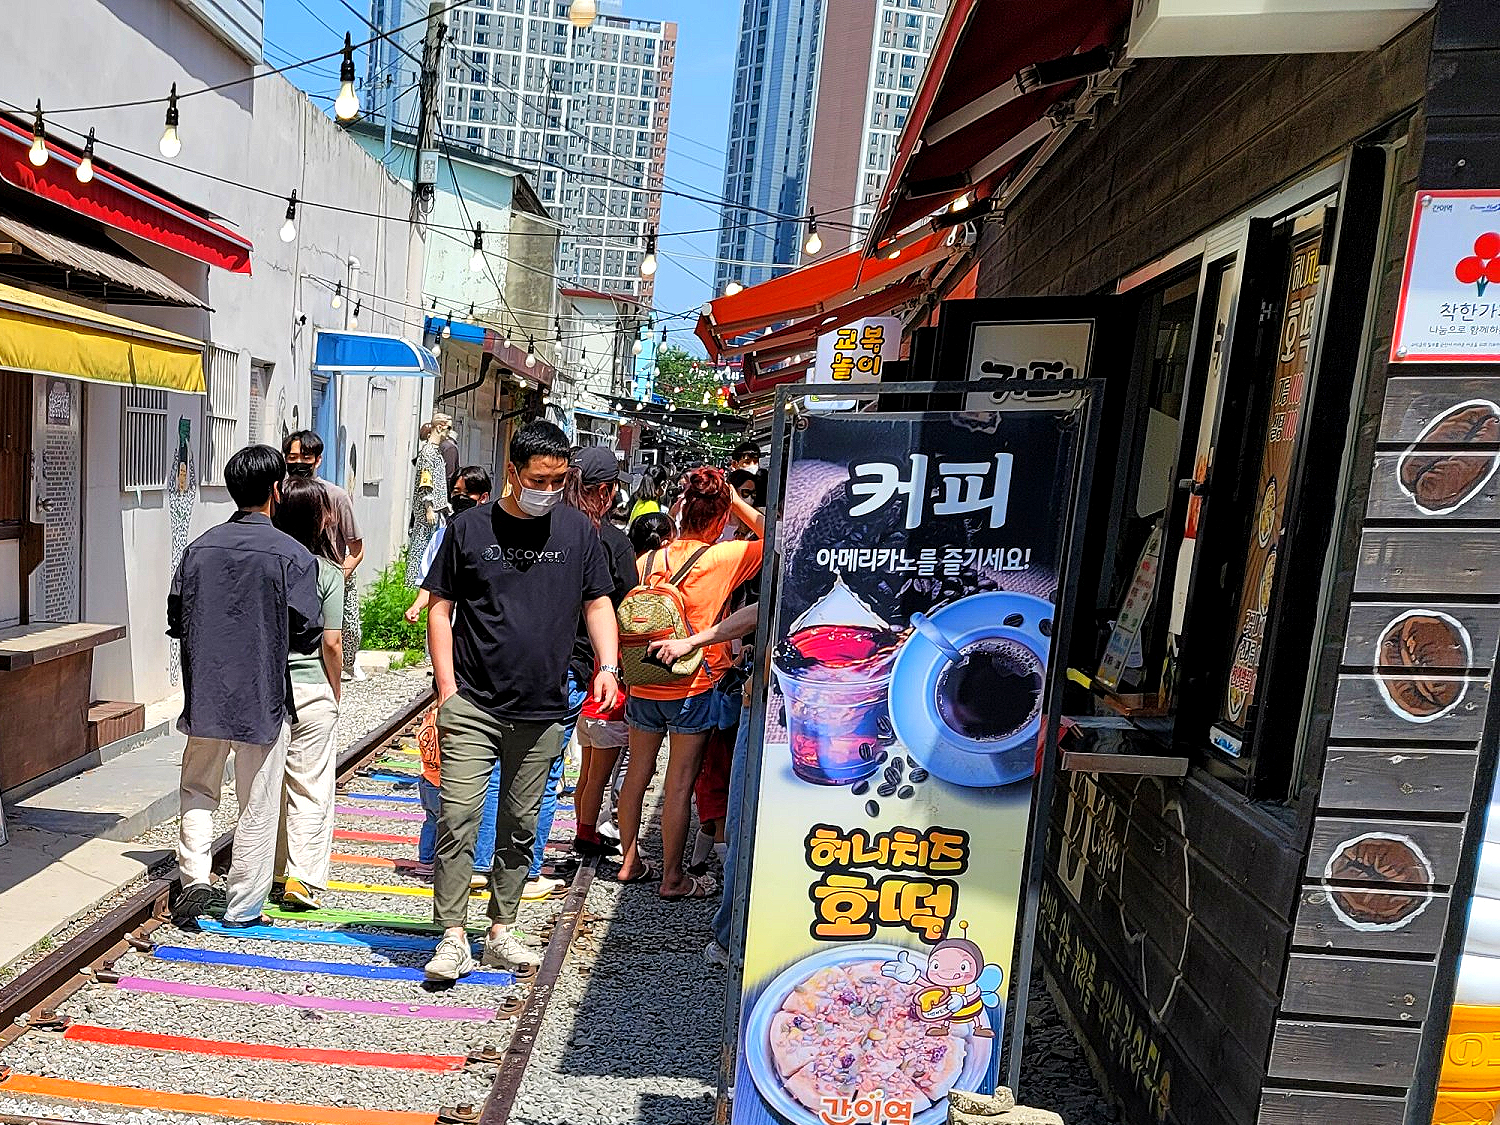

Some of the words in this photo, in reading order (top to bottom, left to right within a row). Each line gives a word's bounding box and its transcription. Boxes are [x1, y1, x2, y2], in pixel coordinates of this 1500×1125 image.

[1440, 302, 1500, 322] 착한가
[833, 325, 885, 354] 교복
[1470, 324, 1500, 336] 함께하
[830, 352, 881, 380] 놀이
[849, 453, 1014, 529] 커피
[816, 548, 938, 576] 아메리카노를
[941, 547, 1031, 576] 즐기세요!
[805, 825, 968, 873] 허니치즈
[810, 872, 958, 942] 호떡
